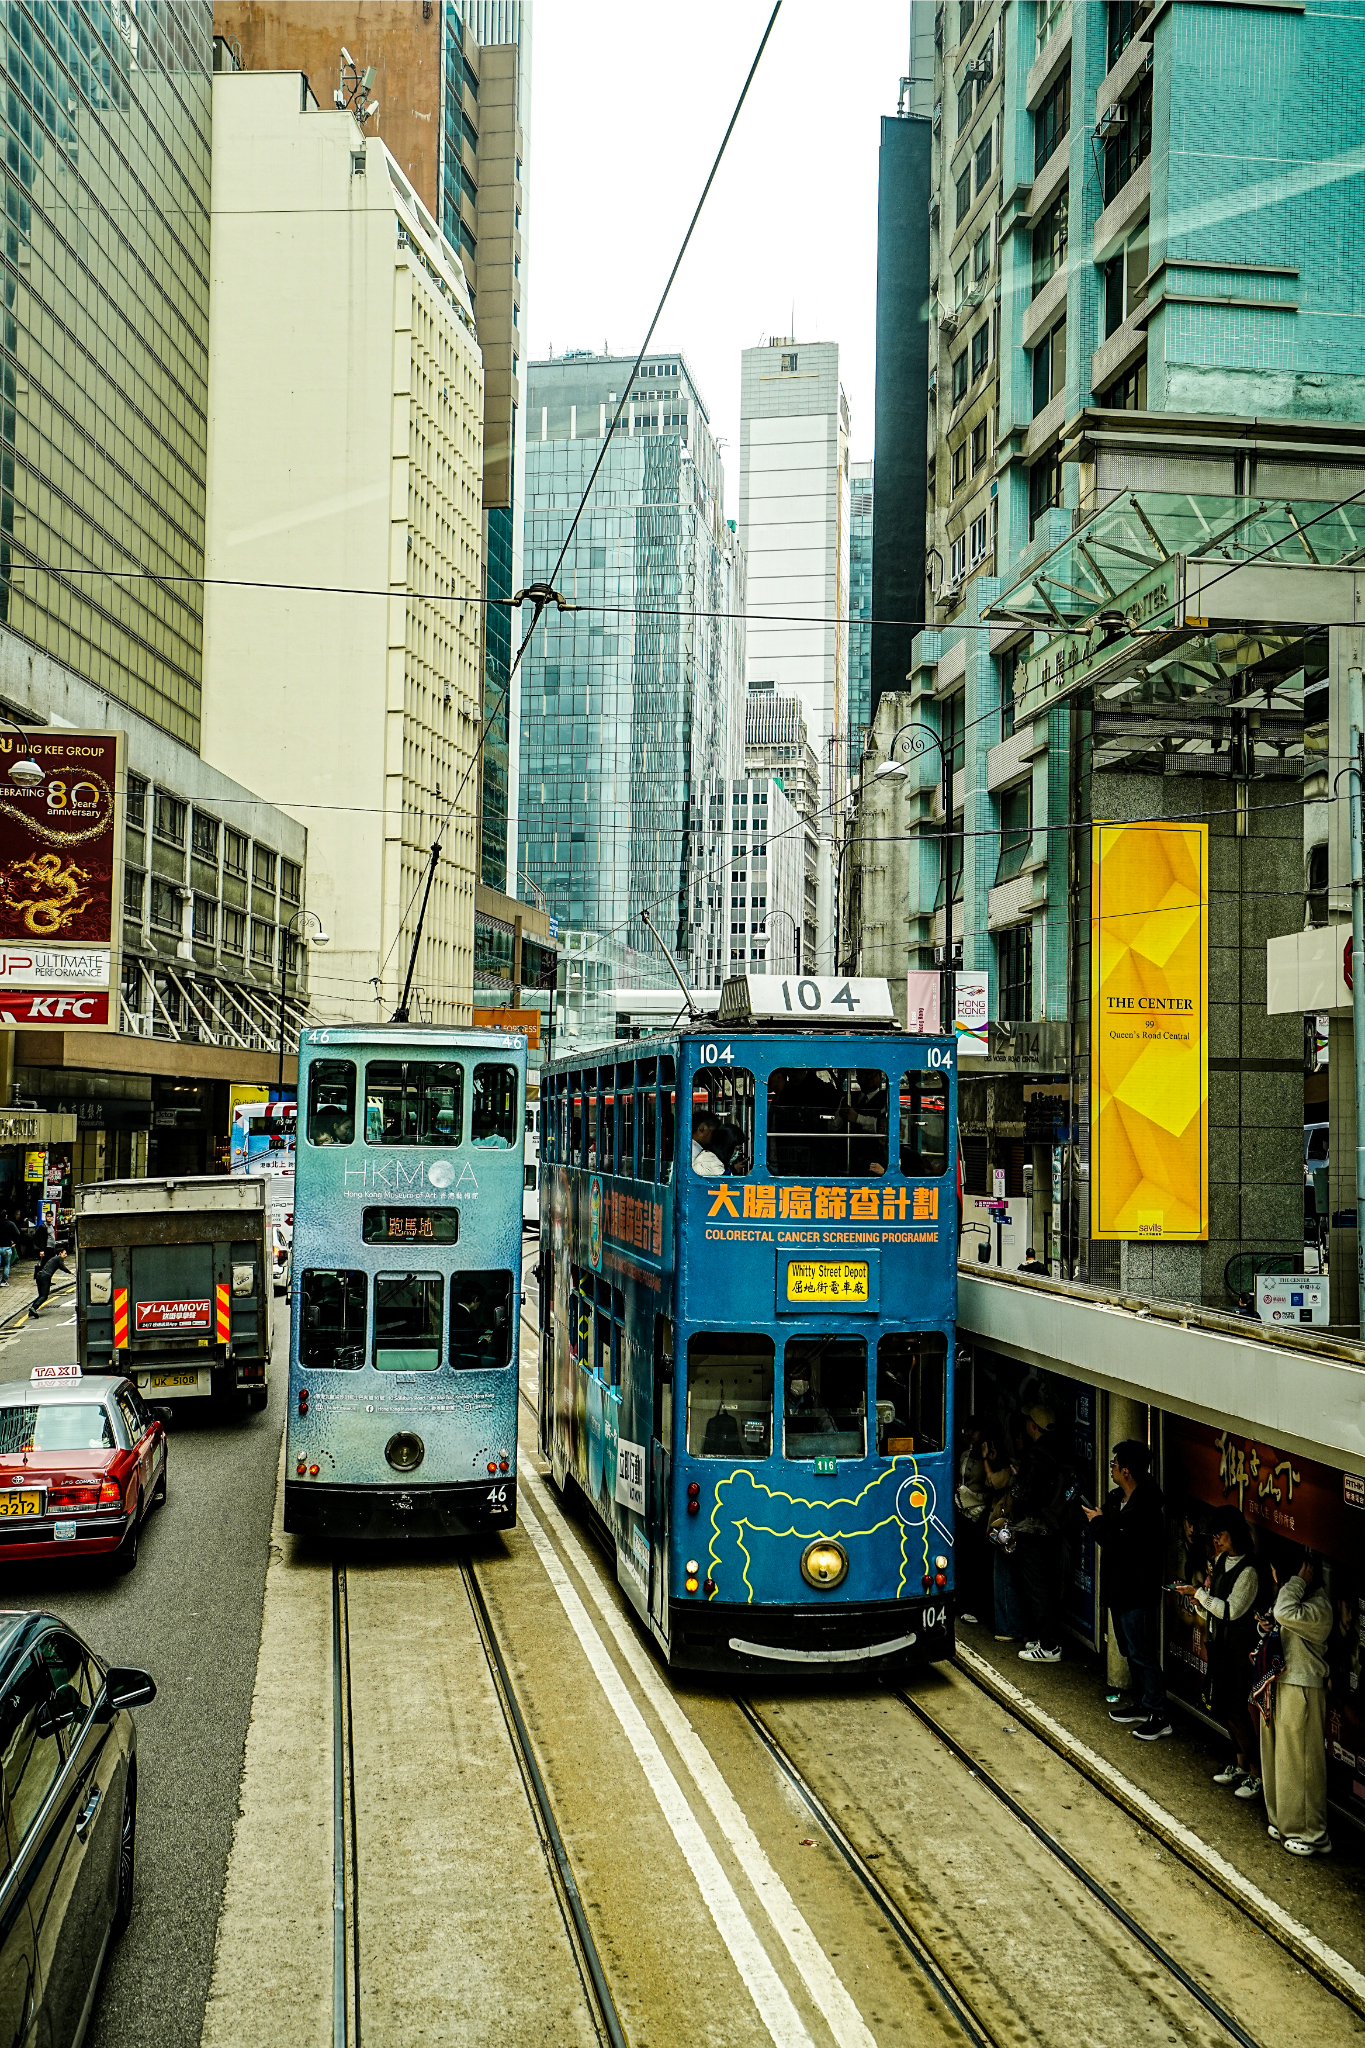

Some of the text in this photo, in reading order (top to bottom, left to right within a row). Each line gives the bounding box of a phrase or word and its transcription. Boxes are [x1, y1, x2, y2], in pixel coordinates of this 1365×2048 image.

[16, 744, 42, 754] LING
[45, 745, 63, 755] KEE
[66, 746, 105, 757] GROUP
[72, 801, 97, 809] years
[47, 808, 101, 818] anniversary
[35, 954, 103, 969] ULTIMATE
[35, 967, 102, 978] PERFORMANCE
[781, 979, 861, 1012] 104
[27, 996, 96, 1019] KFC
[1106, 996, 1194, 1010] THE CENTER
[1145, 1020, 1155, 1028] 99
[308, 1029, 330, 1044] 46
[502, 1034, 522, 1050] 46
[1109, 1030, 1190, 1040] Queen's Road Central
[700, 1044, 735, 1064] 104
[927, 1047, 954, 1069] 104
[343, 1190, 363, 1199] Hong
[364, 1190, 383, 1199] Kong
[384, 1191, 414, 1199] Museum
[425, 1191, 437, 1199] Art
[707, 1183, 939, 1220] 大腸癌篩查計劃
[388, 1217, 434, 1237] 跑馬地
[1138, 1223, 1163, 1232] savills
[705, 1228, 939, 1243] COLORECTAL CANCER SCREENING PROGRAMME
[792, 1264, 867, 1280] Whitty Street Depot
[791, 1280, 866, 1295] 屈地街電車廠
[152, 1302, 210, 1313] LALAMOVE
[35, 1366, 78, 1377] TAXI
[154, 1375, 195, 1387] UK 5108
[816, 1460, 834, 1472] 116
[8, 1492, 28, 1504] FL
[486, 1485, 507, 1503] 46
[0, 1501, 35, 1515] 3212
[922, 1605, 947, 1628] 104
